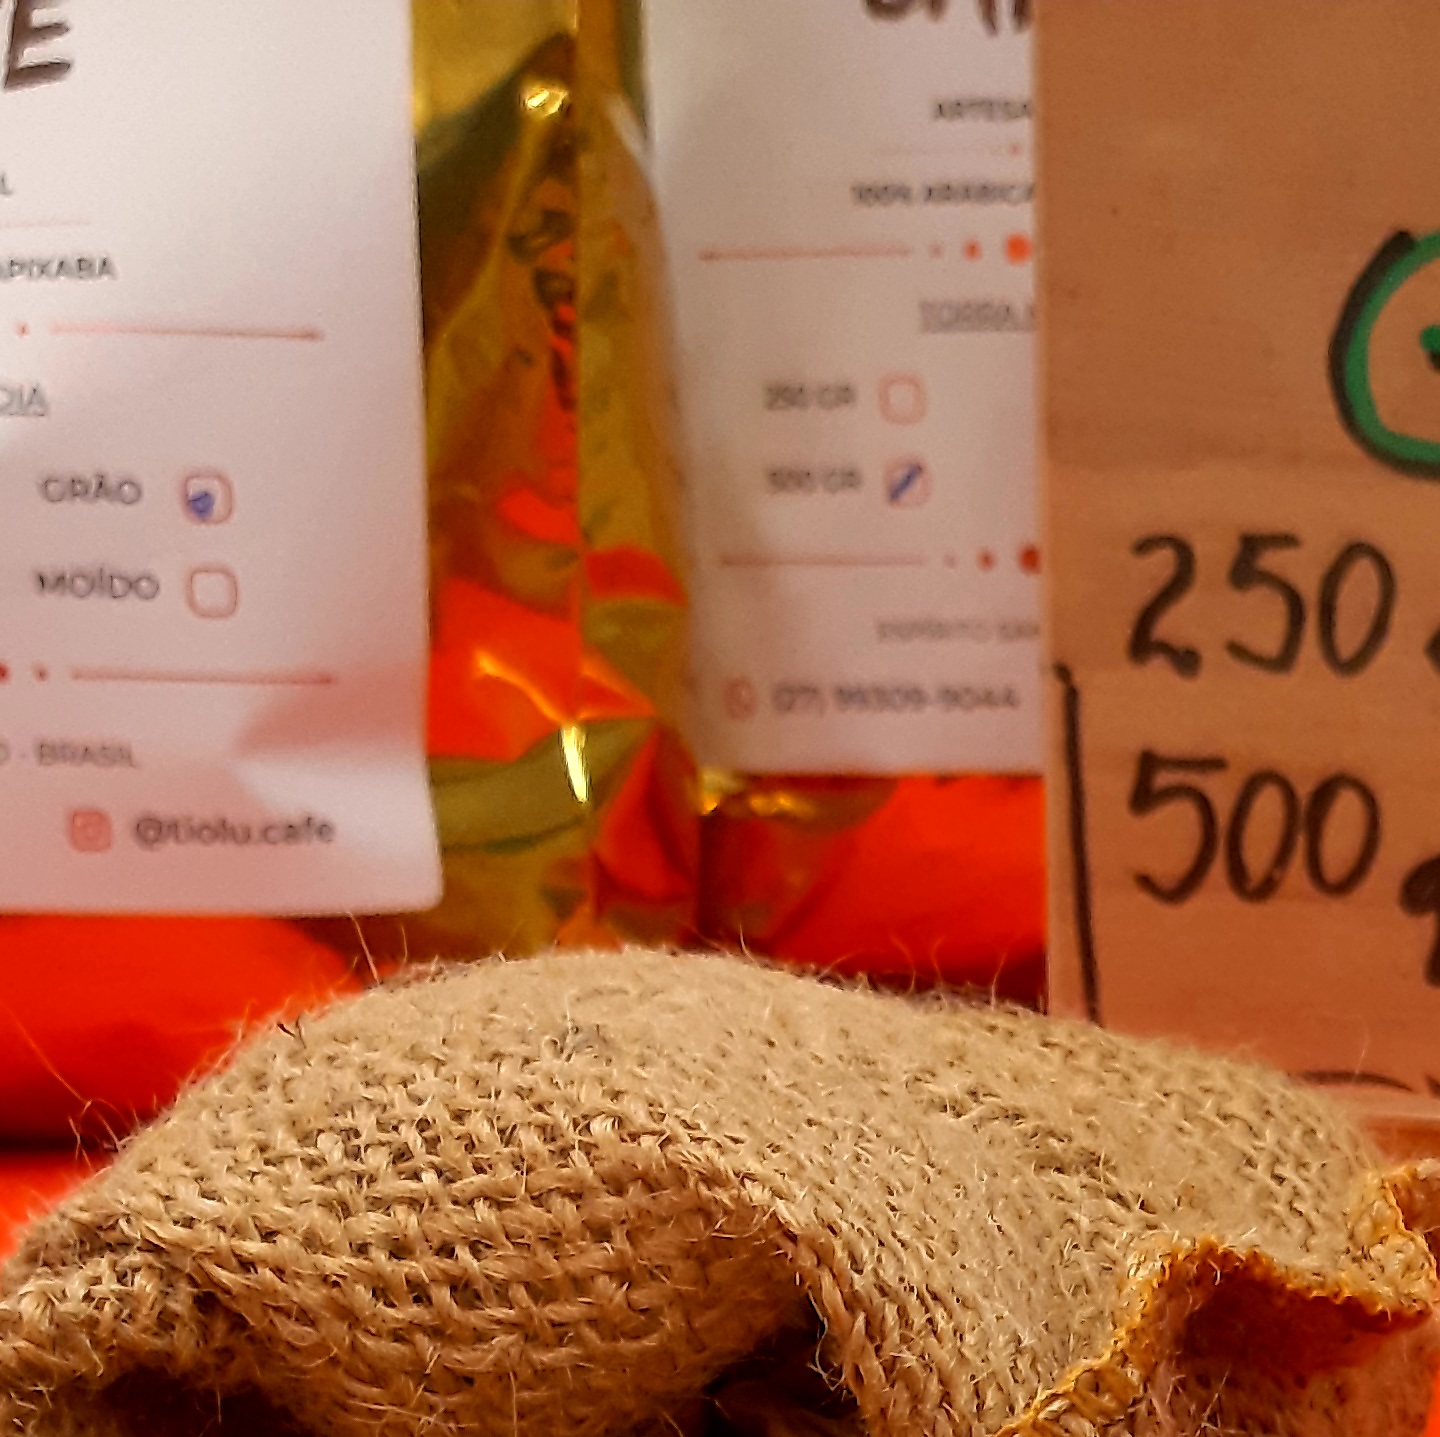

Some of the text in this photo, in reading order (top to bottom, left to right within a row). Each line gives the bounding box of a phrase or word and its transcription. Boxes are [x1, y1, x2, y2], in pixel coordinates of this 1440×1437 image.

[38, 472, 143, 506] GRÃO
[35, 563, 160, 602] MOÍDO
[1125, 532, 1397, 678] 250
[38, 739, 136, 769] BRASIL
[134, 812, 336, 849] @tiolu.cafe
[1127, 750, 1381, 905] 500
